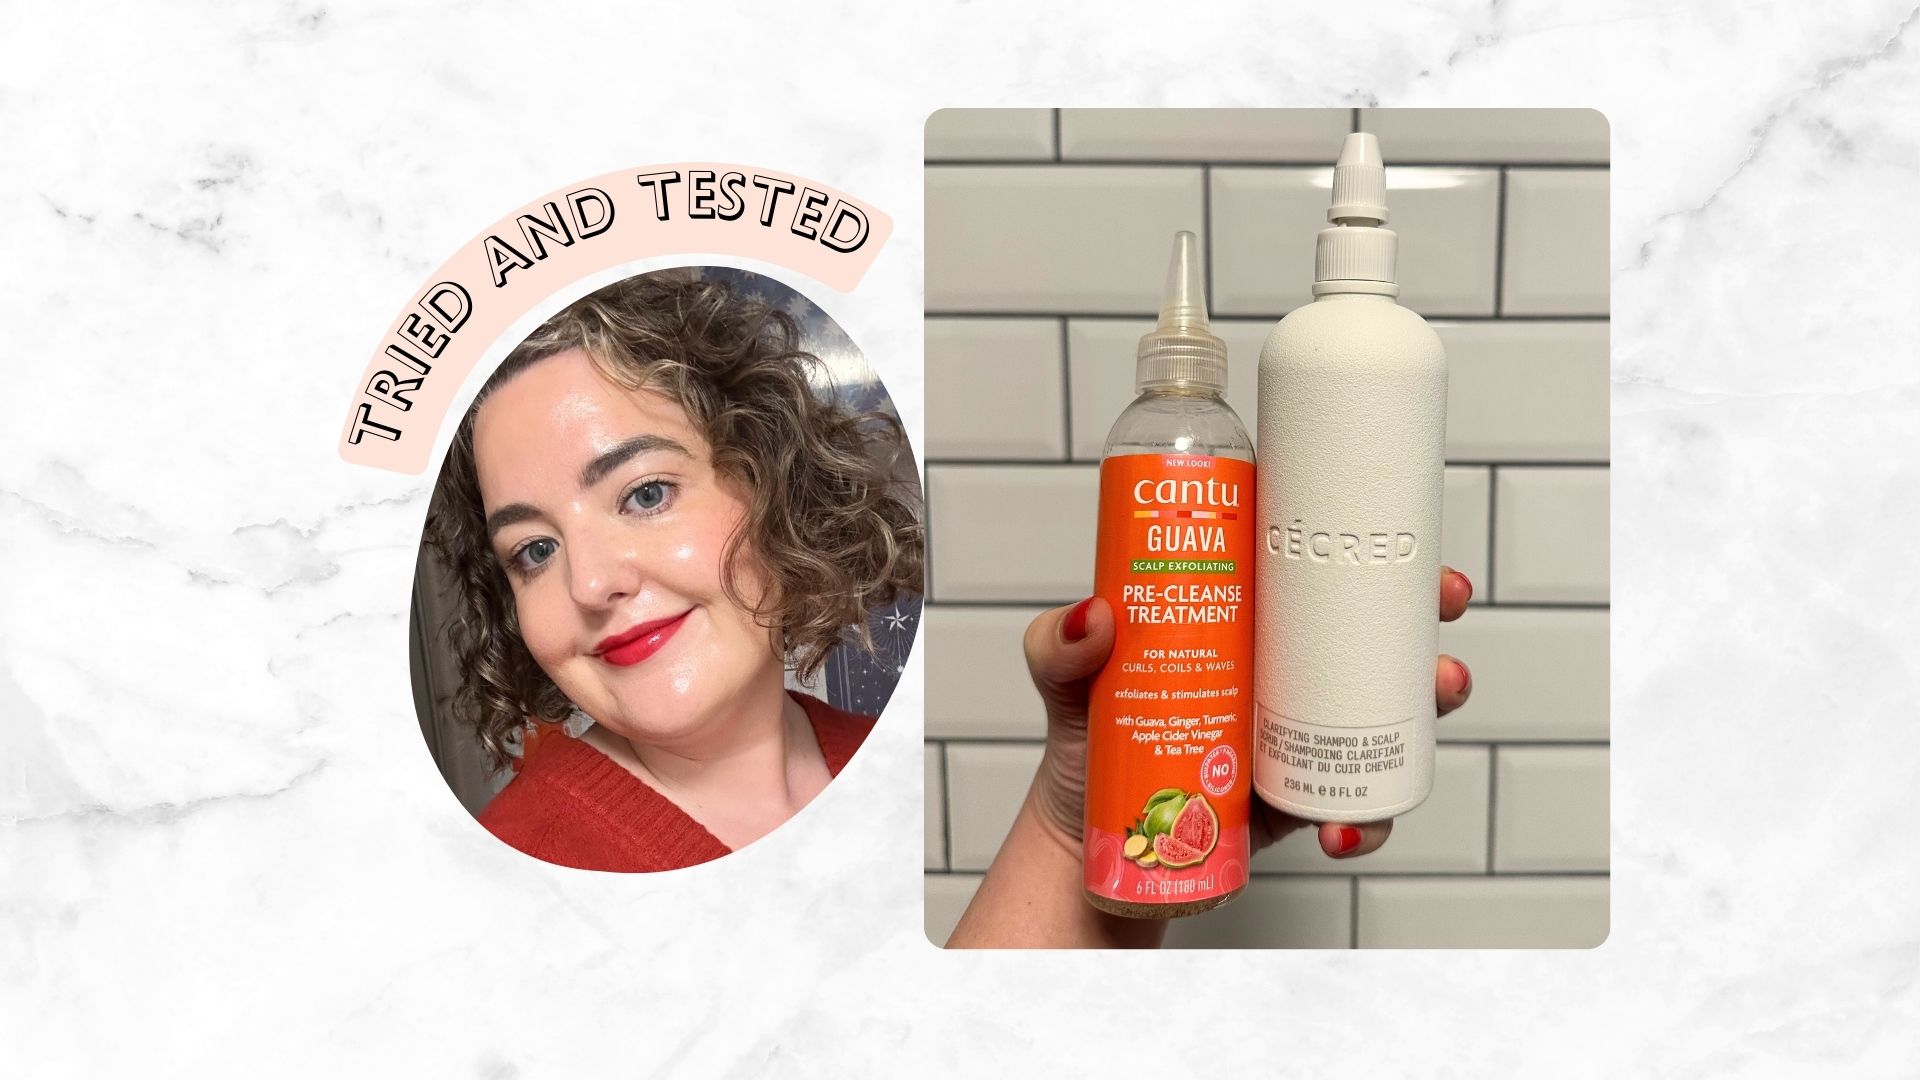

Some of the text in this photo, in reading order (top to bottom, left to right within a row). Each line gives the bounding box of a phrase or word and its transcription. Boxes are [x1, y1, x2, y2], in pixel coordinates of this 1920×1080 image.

[1166, 459, 1211, 468] NEW LOOK!
[1133, 477, 1240, 507] cantu
[1147, 525, 1226, 552] GUAVA
[1267, 519, 1418, 565] CÉCRED
[1133, 562, 1234, 571] SCALP EXFOLIATING
[1123, 585, 1242, 603] PRE-CLEANSE
[1127, 605, 1239, 623] TREATMENT
[1143, 649, 1219, 660] FOR NATURAL
[1122, 661, 1236, 674] CURLS, COILS & WAVES
[1115, 685, 1239, 700] exfoliates & stimulates scalp
[1116, 715, 1134, 726] with
[1135, 715, 1167, 728] Guava,
[1168, 716, 1201, 729] Ginger,
[1132, 728, 1224, 744] Apple Cider Vinegar
[1263, 718, 1400, 748] CLARIFYING SHAMPOO & SCALP
[1154, 744, 1205, 755] & Tea Tree
[1259, 743, 1404, 774] ET EXFOLIANT DU CUIR CHEVELU
[1347, 743, 1405, 761] CLARIFIANT
[1212, 764, 1229, 777] NO
[1284, 777, 1300, 791] 236
[1303, 782, 1315, 795] ML
[1329, 786, 1336, 797] 8
[1339, 787, 1352, 797] FL
[1355, 786, 1368, 797] OZ
[1136, 875, 1214, 895] 6 FL OZ (180 mL)
